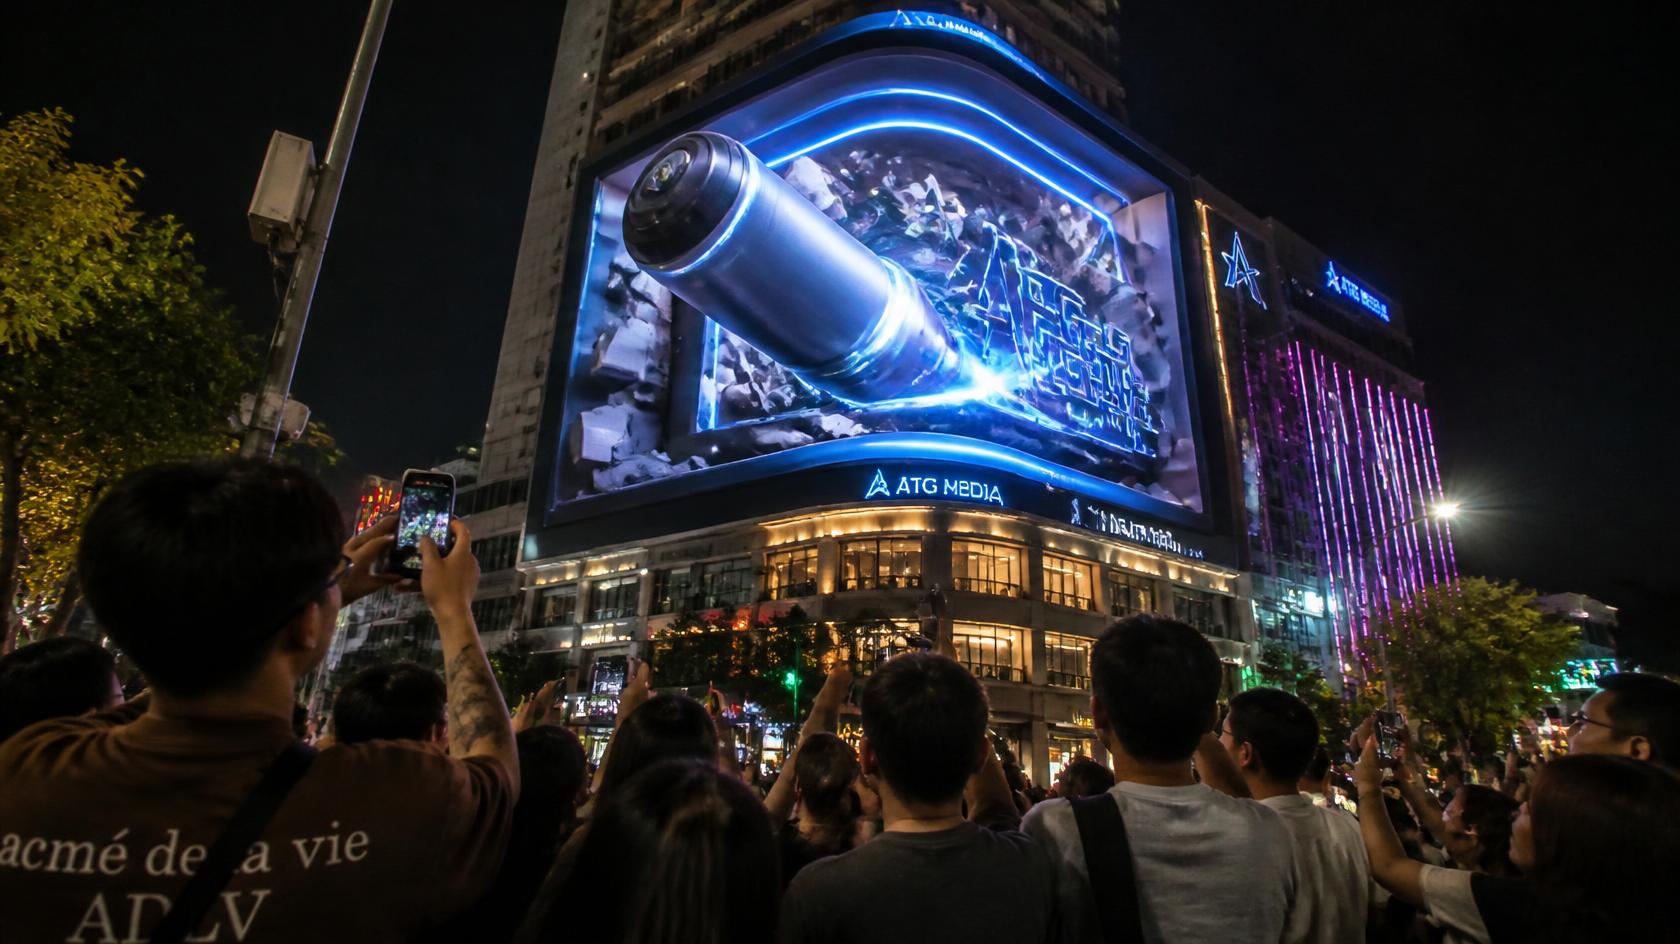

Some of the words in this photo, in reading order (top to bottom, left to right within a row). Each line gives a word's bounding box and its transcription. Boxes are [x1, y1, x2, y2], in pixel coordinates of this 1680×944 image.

[896, 476, 938, 495] ATG
[0, 827, 130, 876] acmé
[144, 828, 208, 877] de
[292, 820, 370, 869] vie
